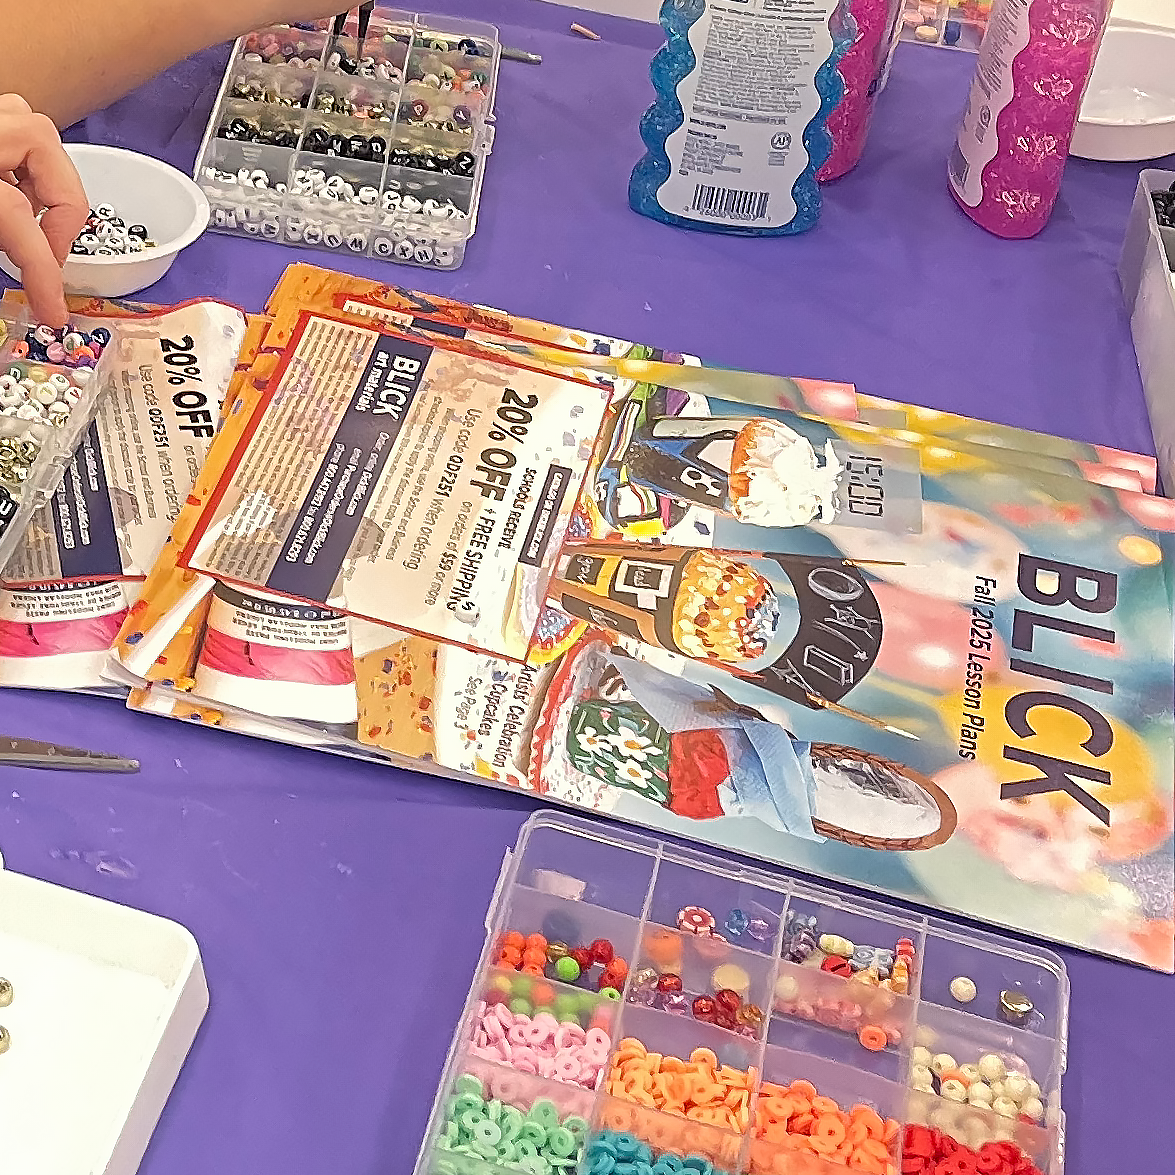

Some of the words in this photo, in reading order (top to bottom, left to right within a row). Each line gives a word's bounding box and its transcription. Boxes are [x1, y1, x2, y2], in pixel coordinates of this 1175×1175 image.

[160, 335, 203, 385] 20%
[375, 351, 390, 368] art
[354, 367, 383, 412] materials
[373, 355, 421, 421] BLICK
[172, 390, 214, 438] OFF
[462, 409, 482, 428] Use
[488, 388, 539, 444] 20%
[452, 428, 471, 454] code
[435, 454, 464, 498] QDF251
[470, 448, 517, 501] OFF
[423, 498, 446, 526] when
[460, 501, 473, 513] on
[470, 515, 497, 549] FREE
[974, 575, 996, 607] Fall
[969, 605, 996, 652] 2025
[465, 676, 483, 695] See
[964, 652, 991, 710] Lesson
[1000, 552, 1118, 827] BLICK
[455, 695, 476, 720] Page
[478, 684, 508, 736] Cupcakes
[492, 705, 525, 768] Celebration
[958, 712, 985, 761] Plans
